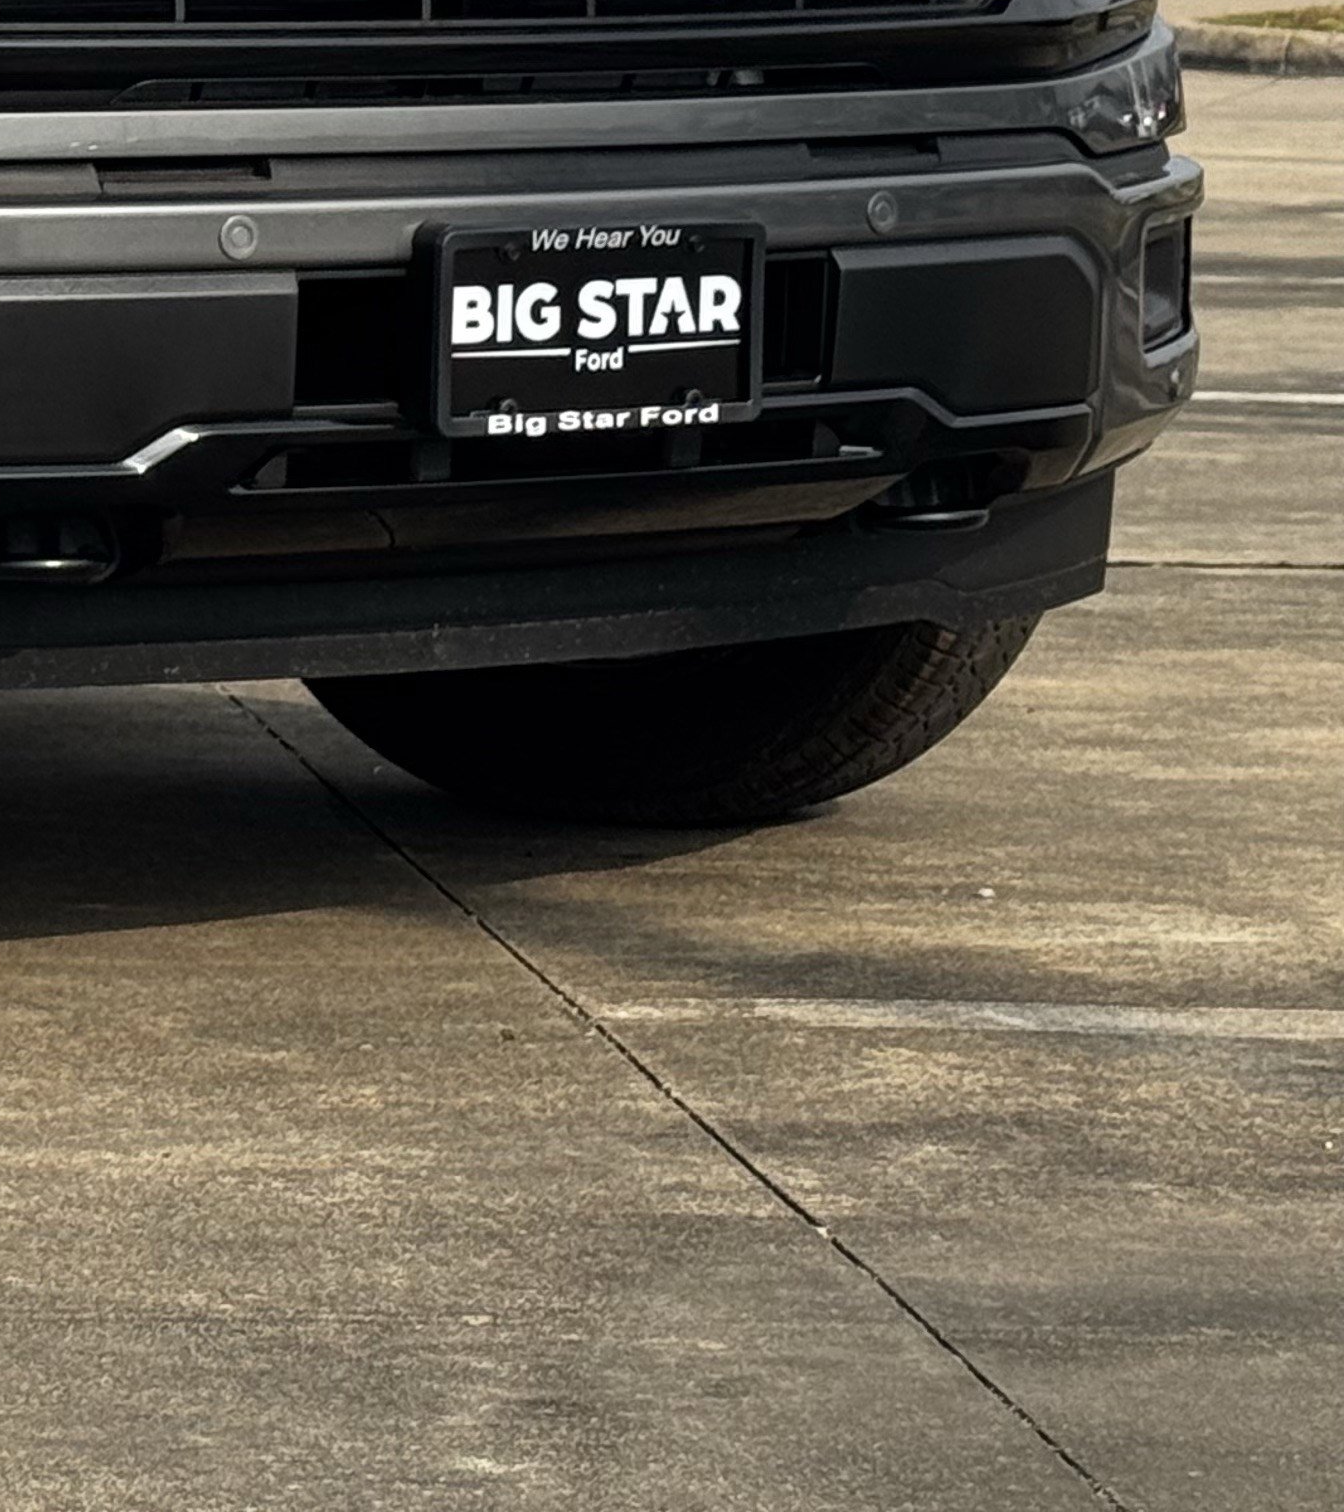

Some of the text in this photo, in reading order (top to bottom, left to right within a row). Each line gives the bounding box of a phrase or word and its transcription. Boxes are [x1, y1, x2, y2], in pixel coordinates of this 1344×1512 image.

[531, 224, 681, 251] We Hear You
[450, 274, 742, 345] BIG STAR
[575, 346, 624, 372] Ford
[487, 402, 720, 437] Big Star Ford
